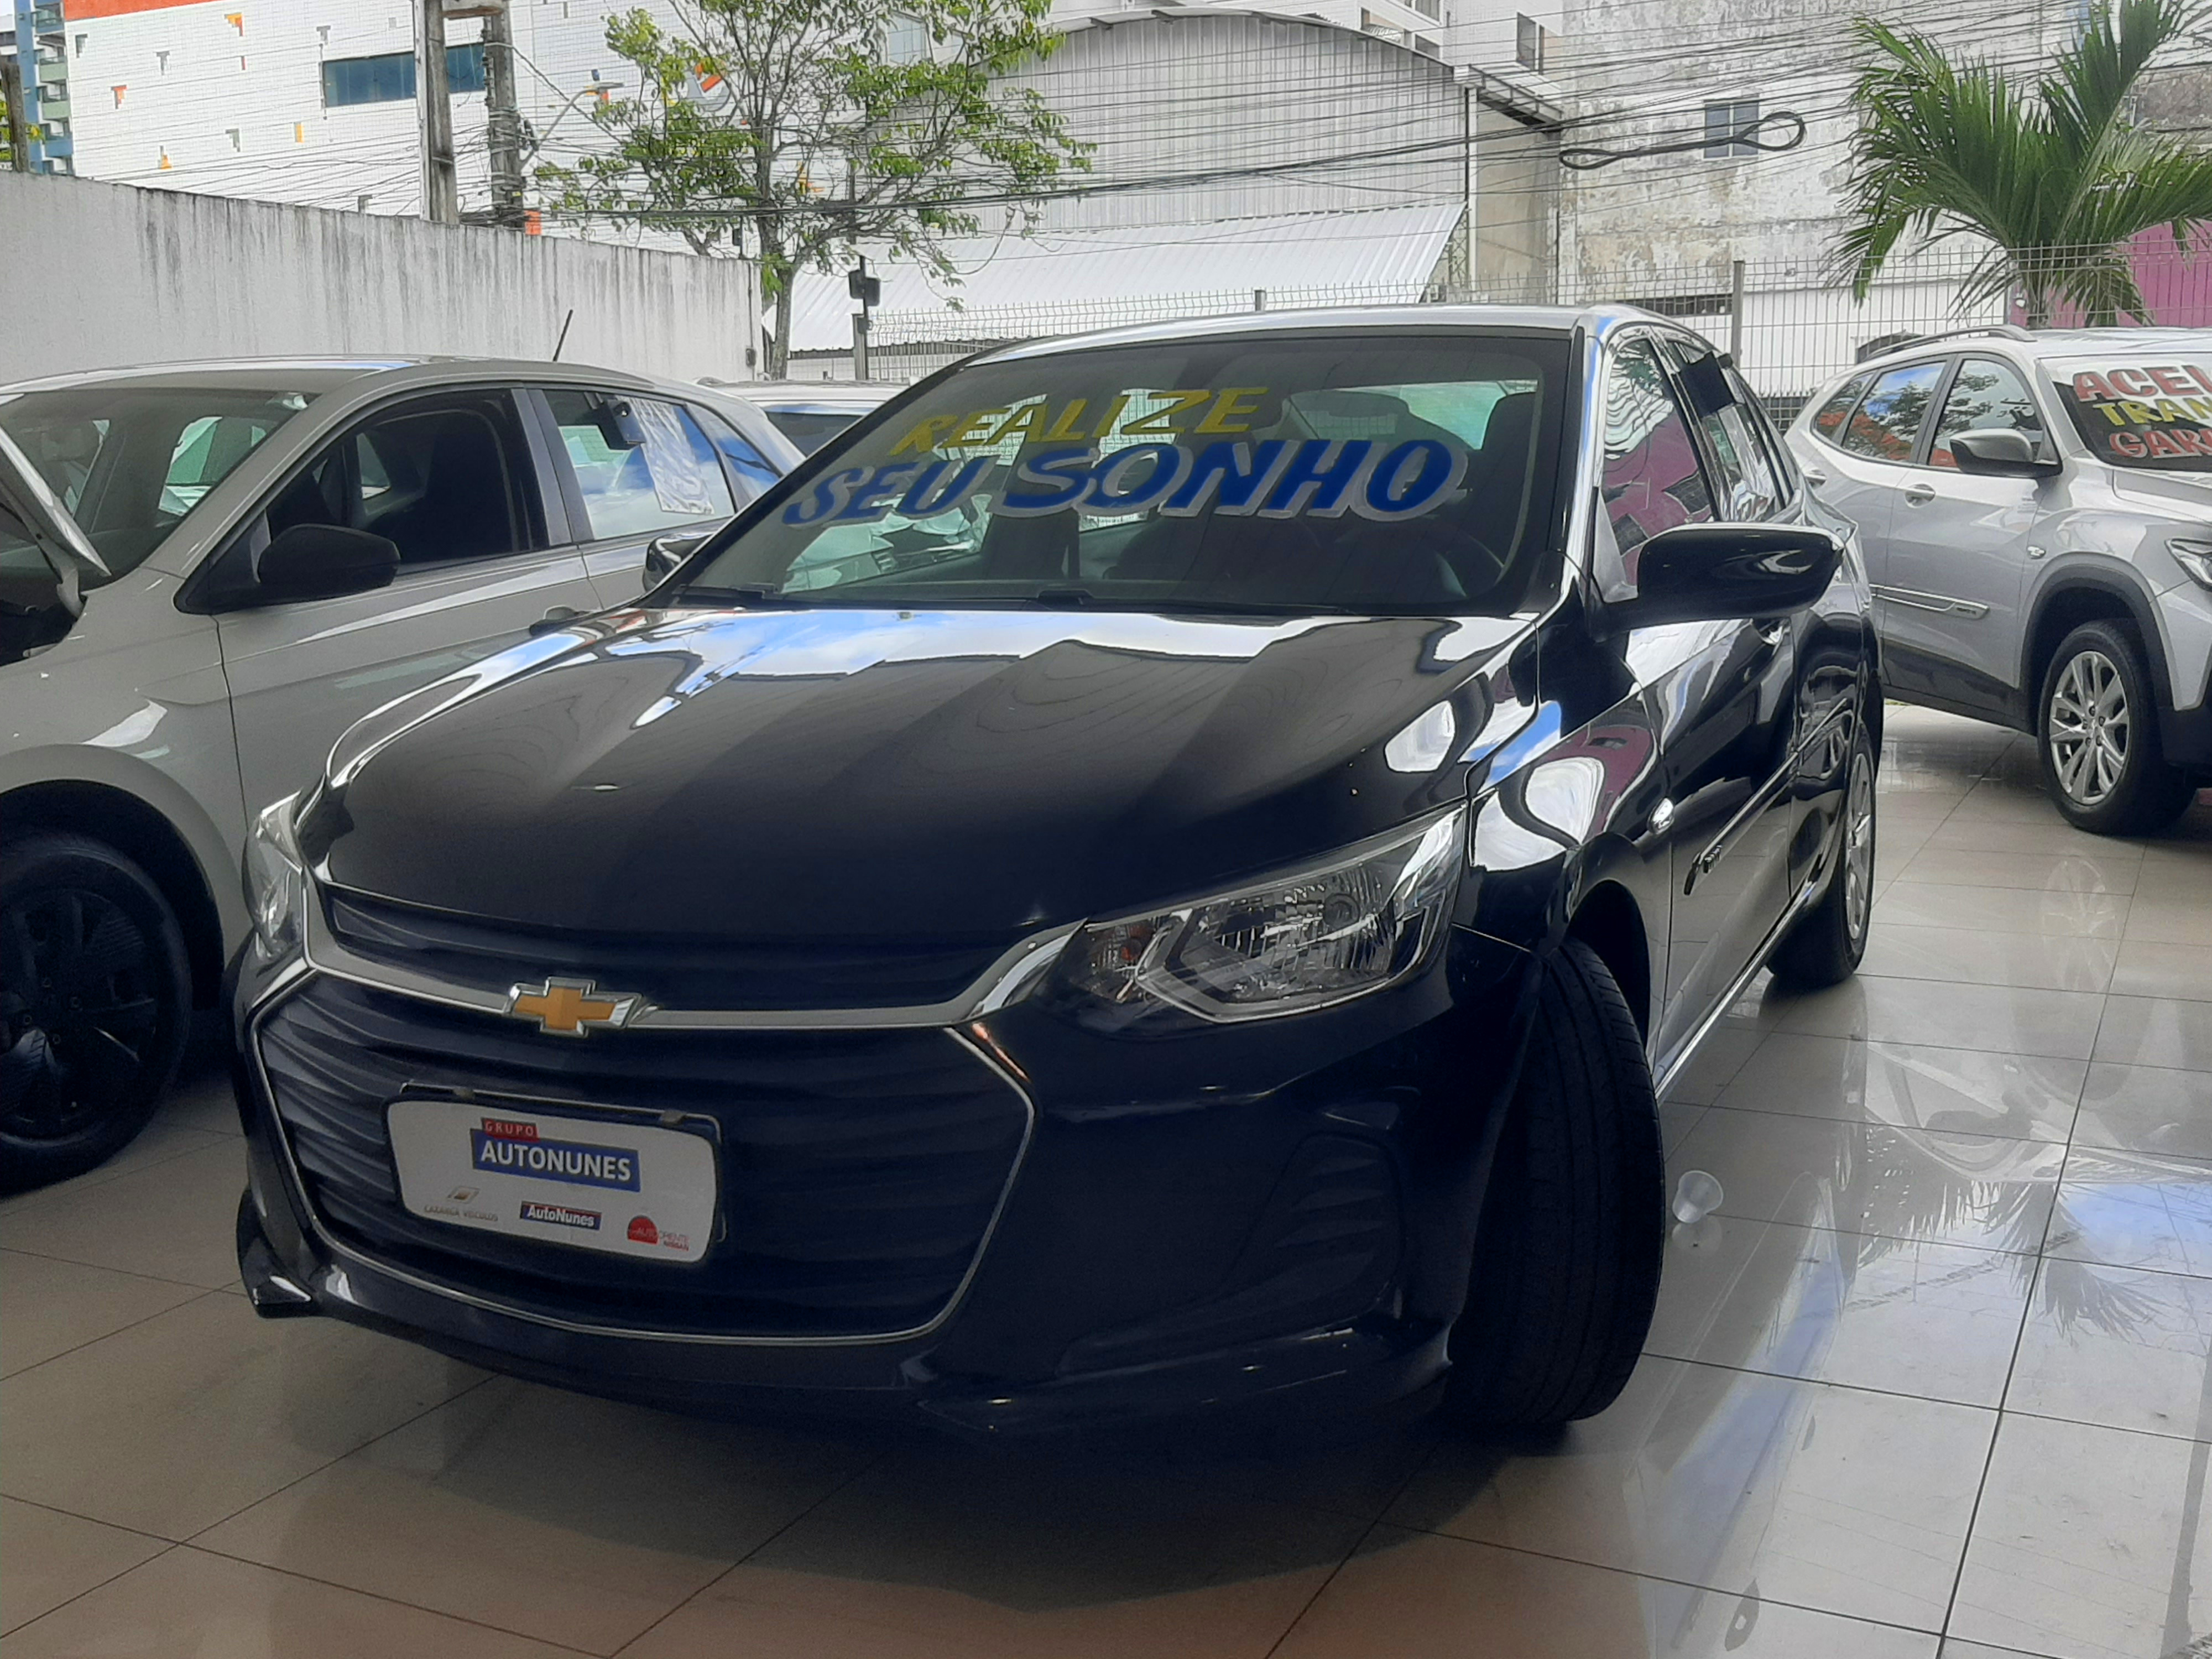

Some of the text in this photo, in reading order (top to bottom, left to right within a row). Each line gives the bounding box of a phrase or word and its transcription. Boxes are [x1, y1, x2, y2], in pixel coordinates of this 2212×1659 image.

[889, 388, 1269, 456] REALIZE
[782, 440, 1468, 529] SEU SONHO
[485, 1120, 534, 1136] GRUPO
[481, 1140, 631, 1181] AUTONUNES
[526, 1204, 594, 1227] AutoNunes
